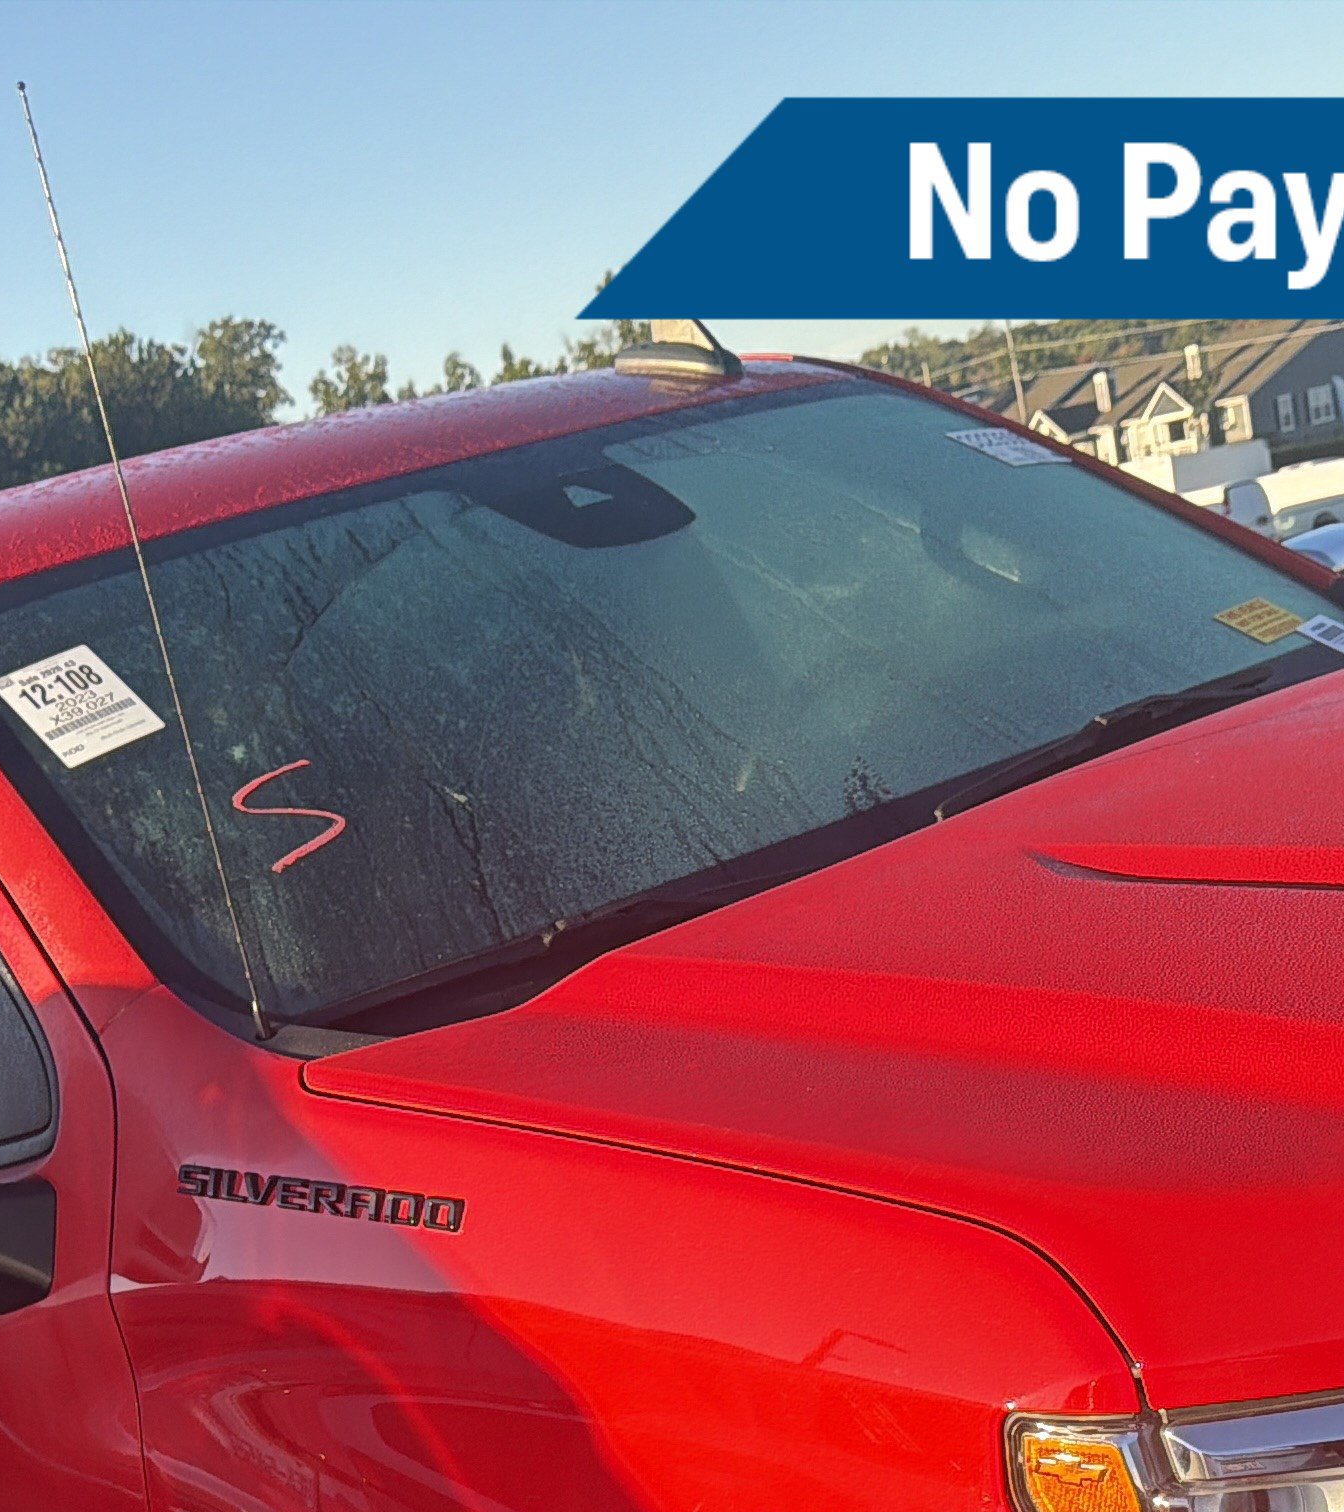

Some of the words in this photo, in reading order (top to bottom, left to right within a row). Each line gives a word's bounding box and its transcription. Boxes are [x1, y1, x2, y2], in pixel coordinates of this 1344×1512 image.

[19, 664, 103, 710] 12:108
[55, 690, 97, 713] 2023
[231, 758, 347, 874] S
[176, 1162, 468, 1235] SILVERADO
